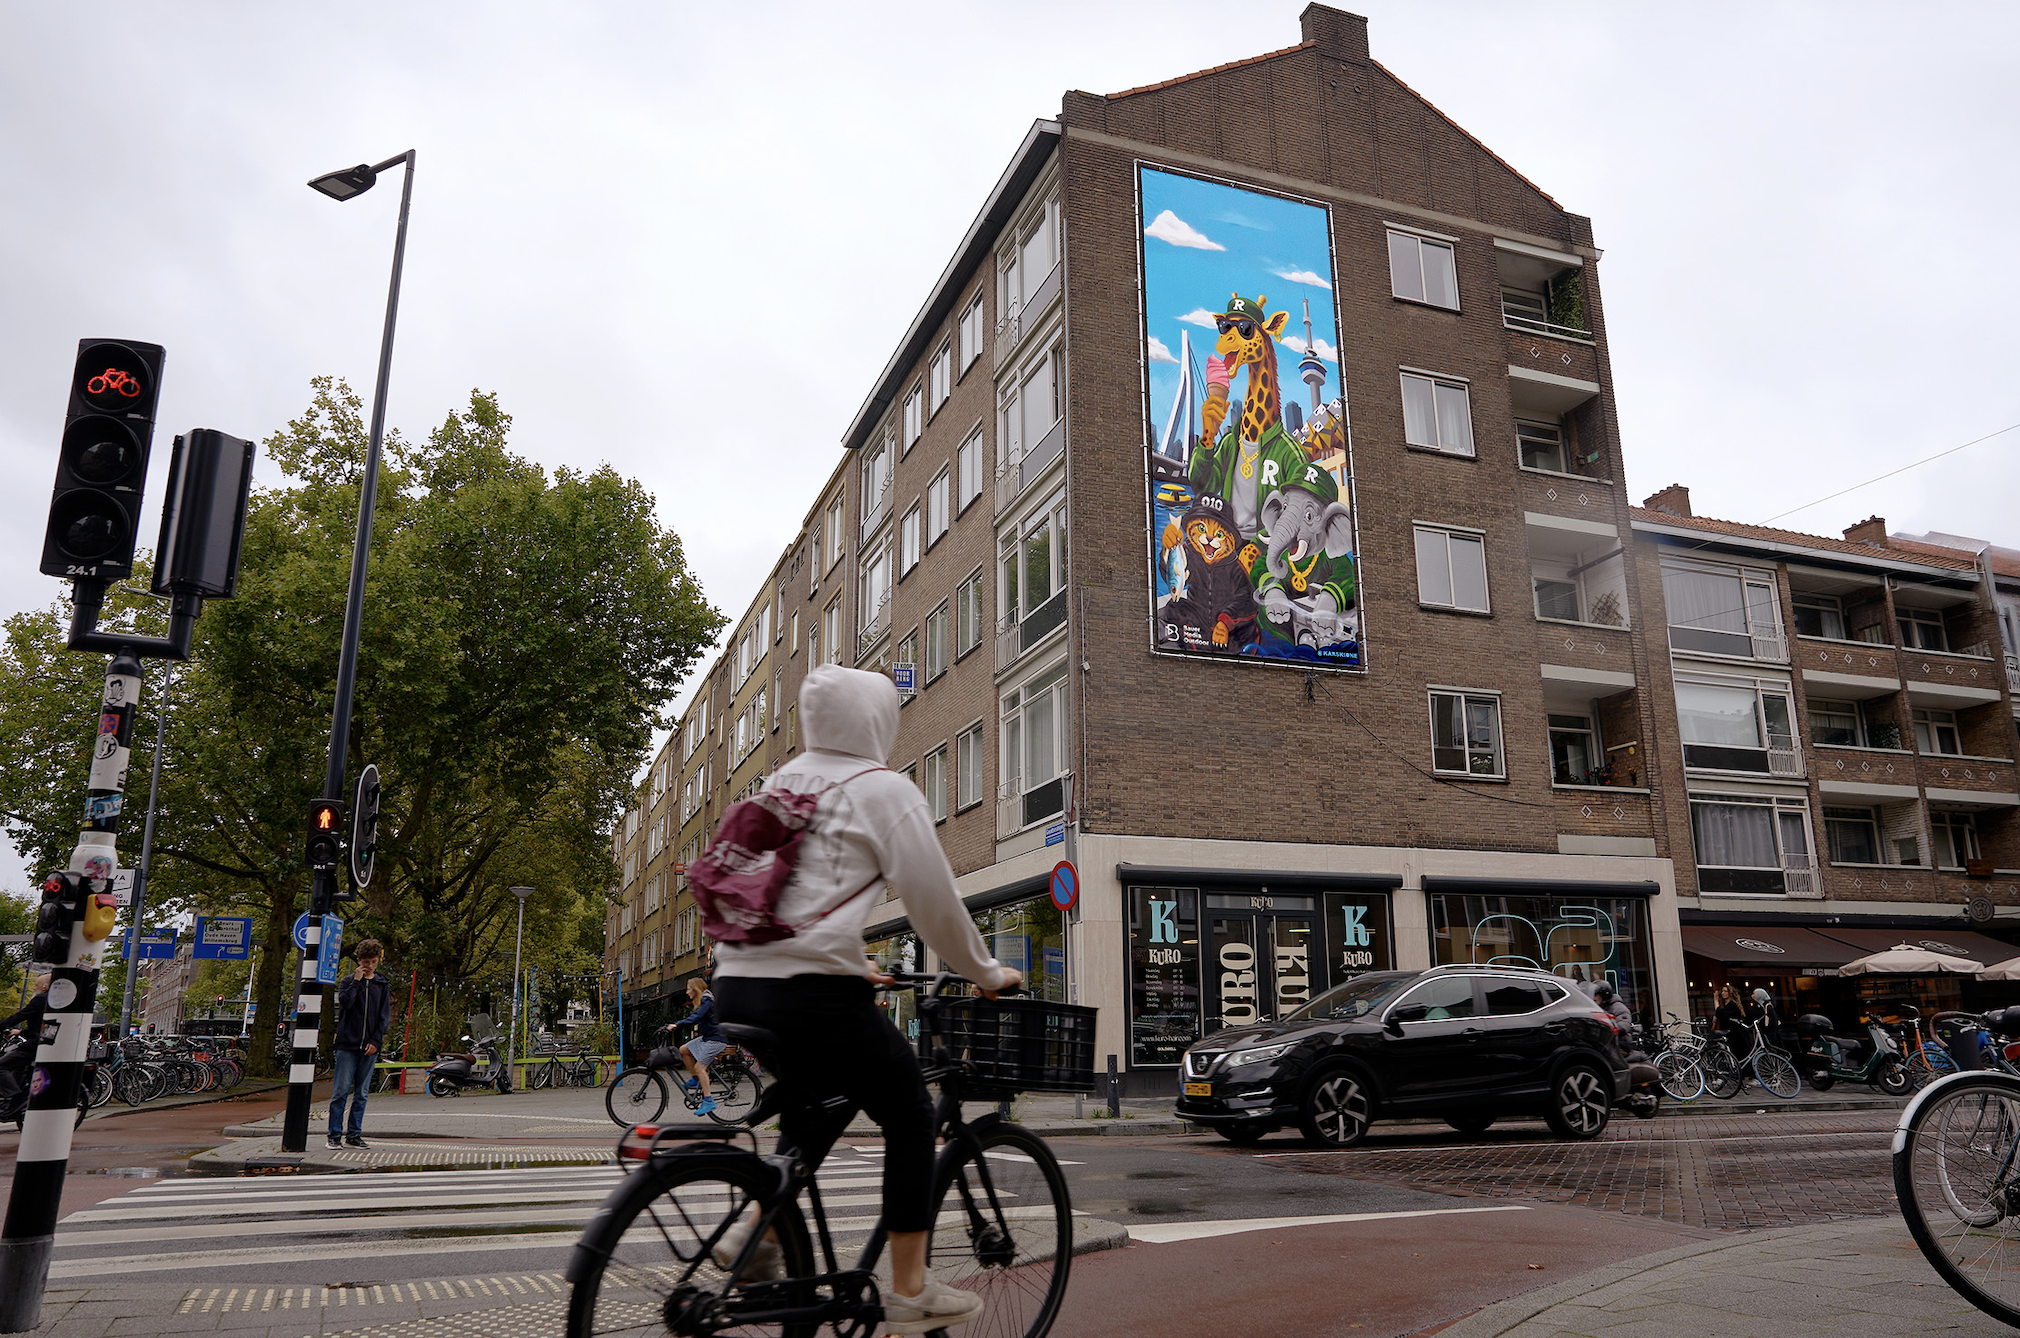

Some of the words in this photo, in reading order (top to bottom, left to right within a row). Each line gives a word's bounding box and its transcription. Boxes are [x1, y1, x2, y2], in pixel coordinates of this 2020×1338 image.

[1232, 299, 1245, 311] R
[1261, 459, 1280, 486] R
[1303, 466, 1319, 485] R
[1201, 496, 1224, 511] 010
[66, 565, 97, 576] 24.1
[1183, 631, 1202, 639] Media
[1183, 637, 1209, 646] Outdoor
[1148, 900, 1179, 943] K
[1341, 905, 1370, 947] K
[1148, 948, 1182, 966] KURO
[1342, 950, 1373, 967] KURO
[1219, 942, 1257, 1028] URO
[1274, 944, 1310, 1015] KU
